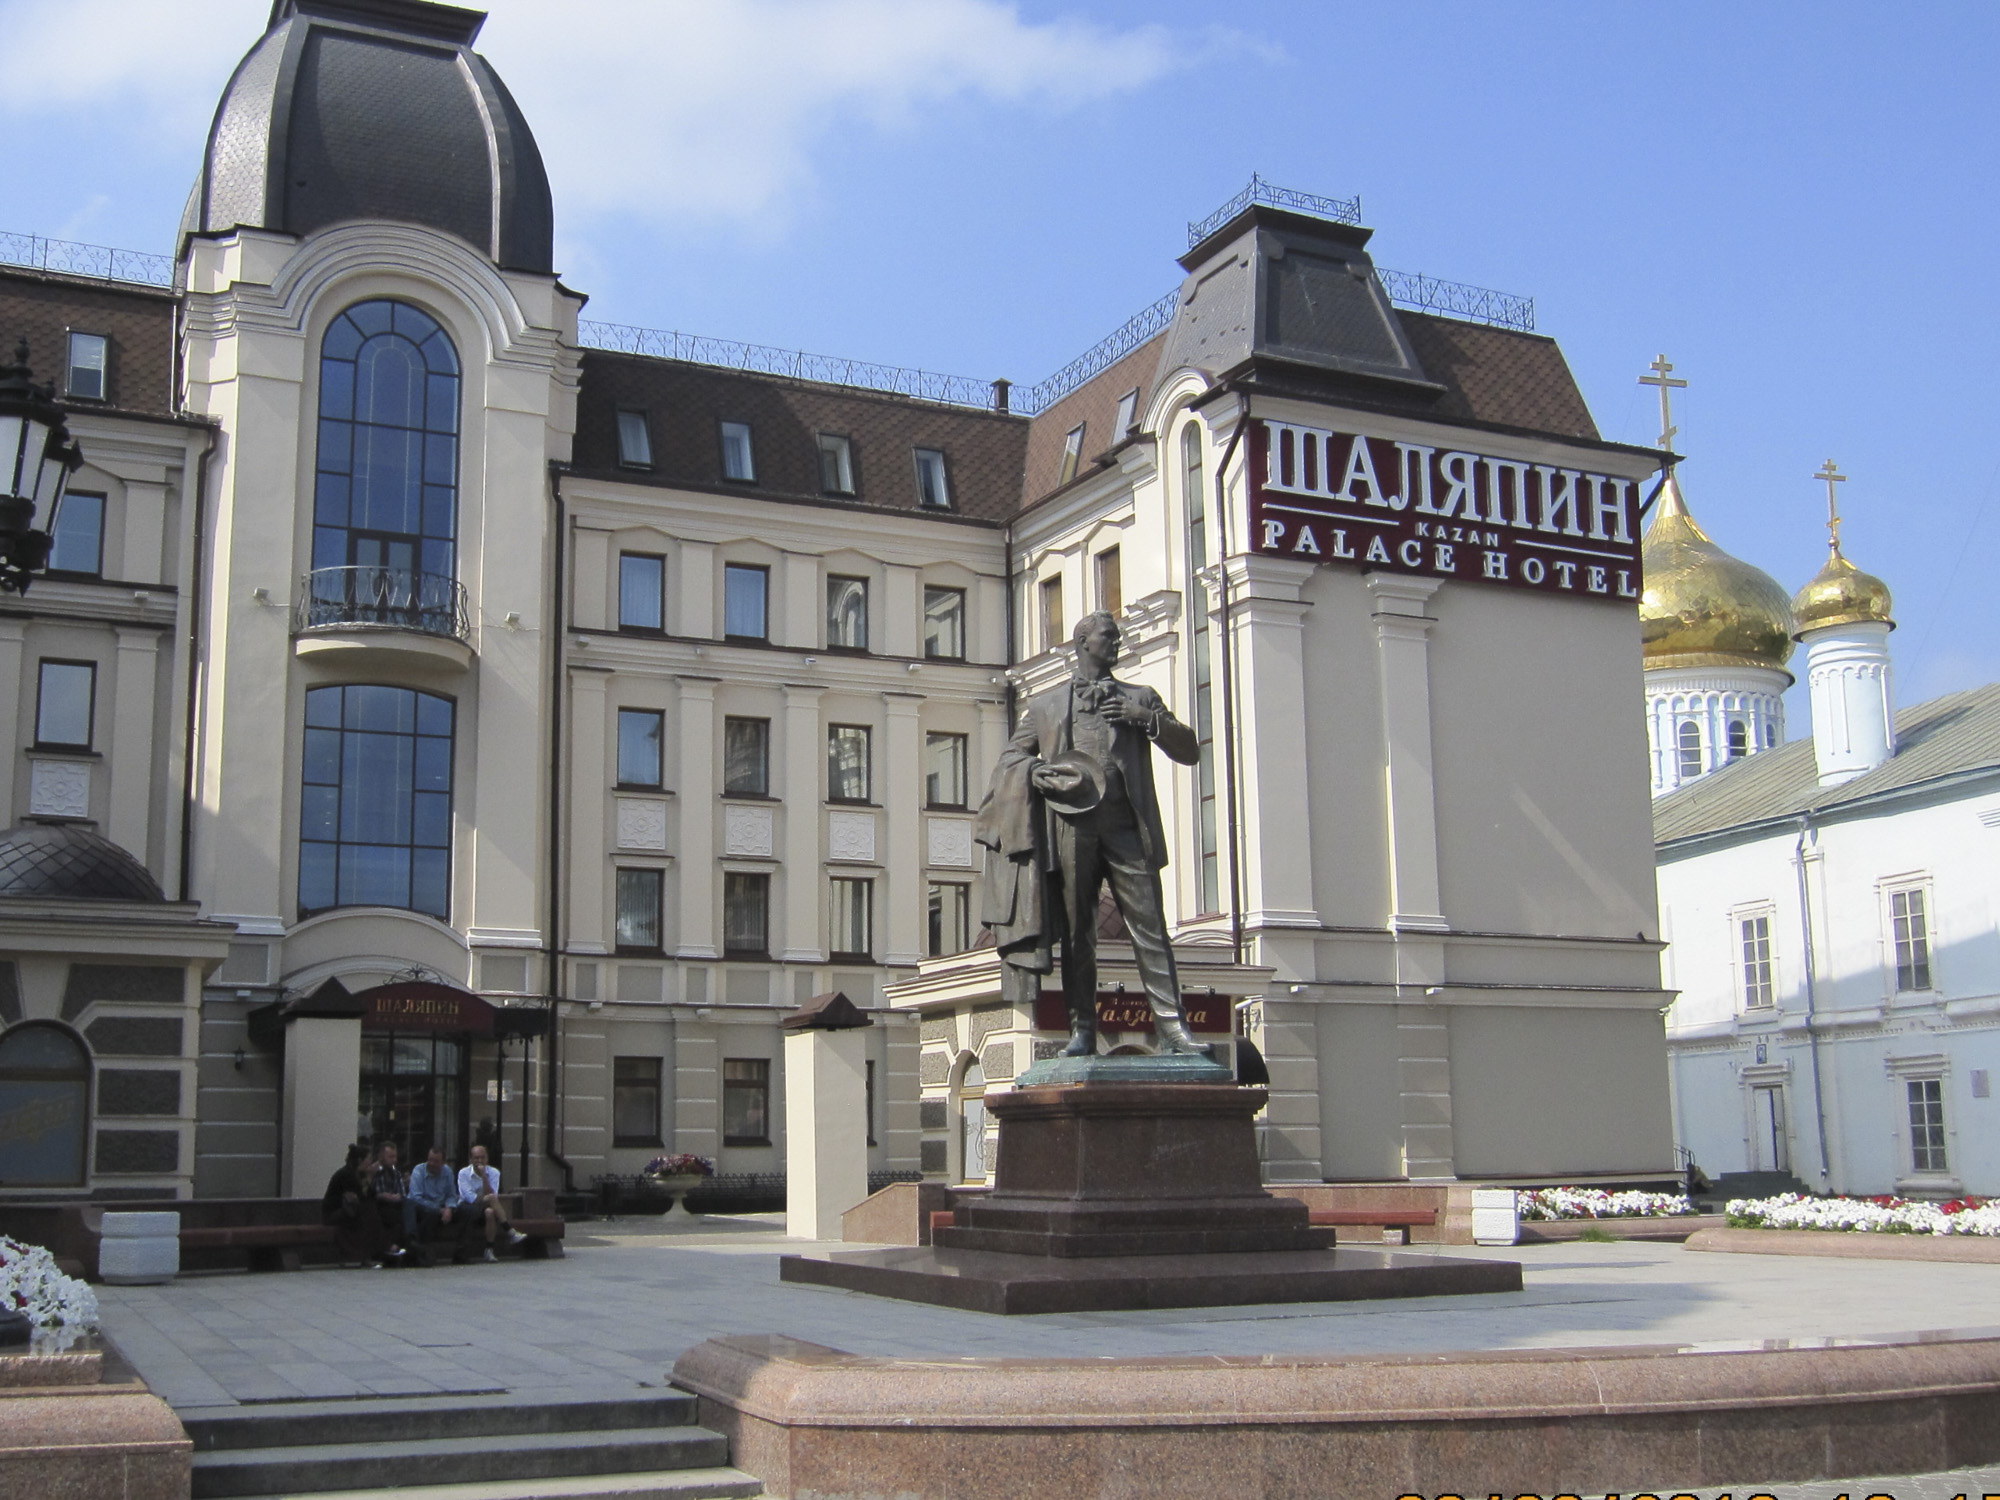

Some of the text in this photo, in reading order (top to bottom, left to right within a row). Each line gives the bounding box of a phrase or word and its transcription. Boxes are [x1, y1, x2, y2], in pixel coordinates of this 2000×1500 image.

[1262, 420, 1633, 544] ШАЛЯПИН
[1262, 519, 1637, 597] PALACE HOTEL
[1415, 522, 1498, 547] KAZAN
[375, 998, 459, 1015] ШАЛЯПИН
